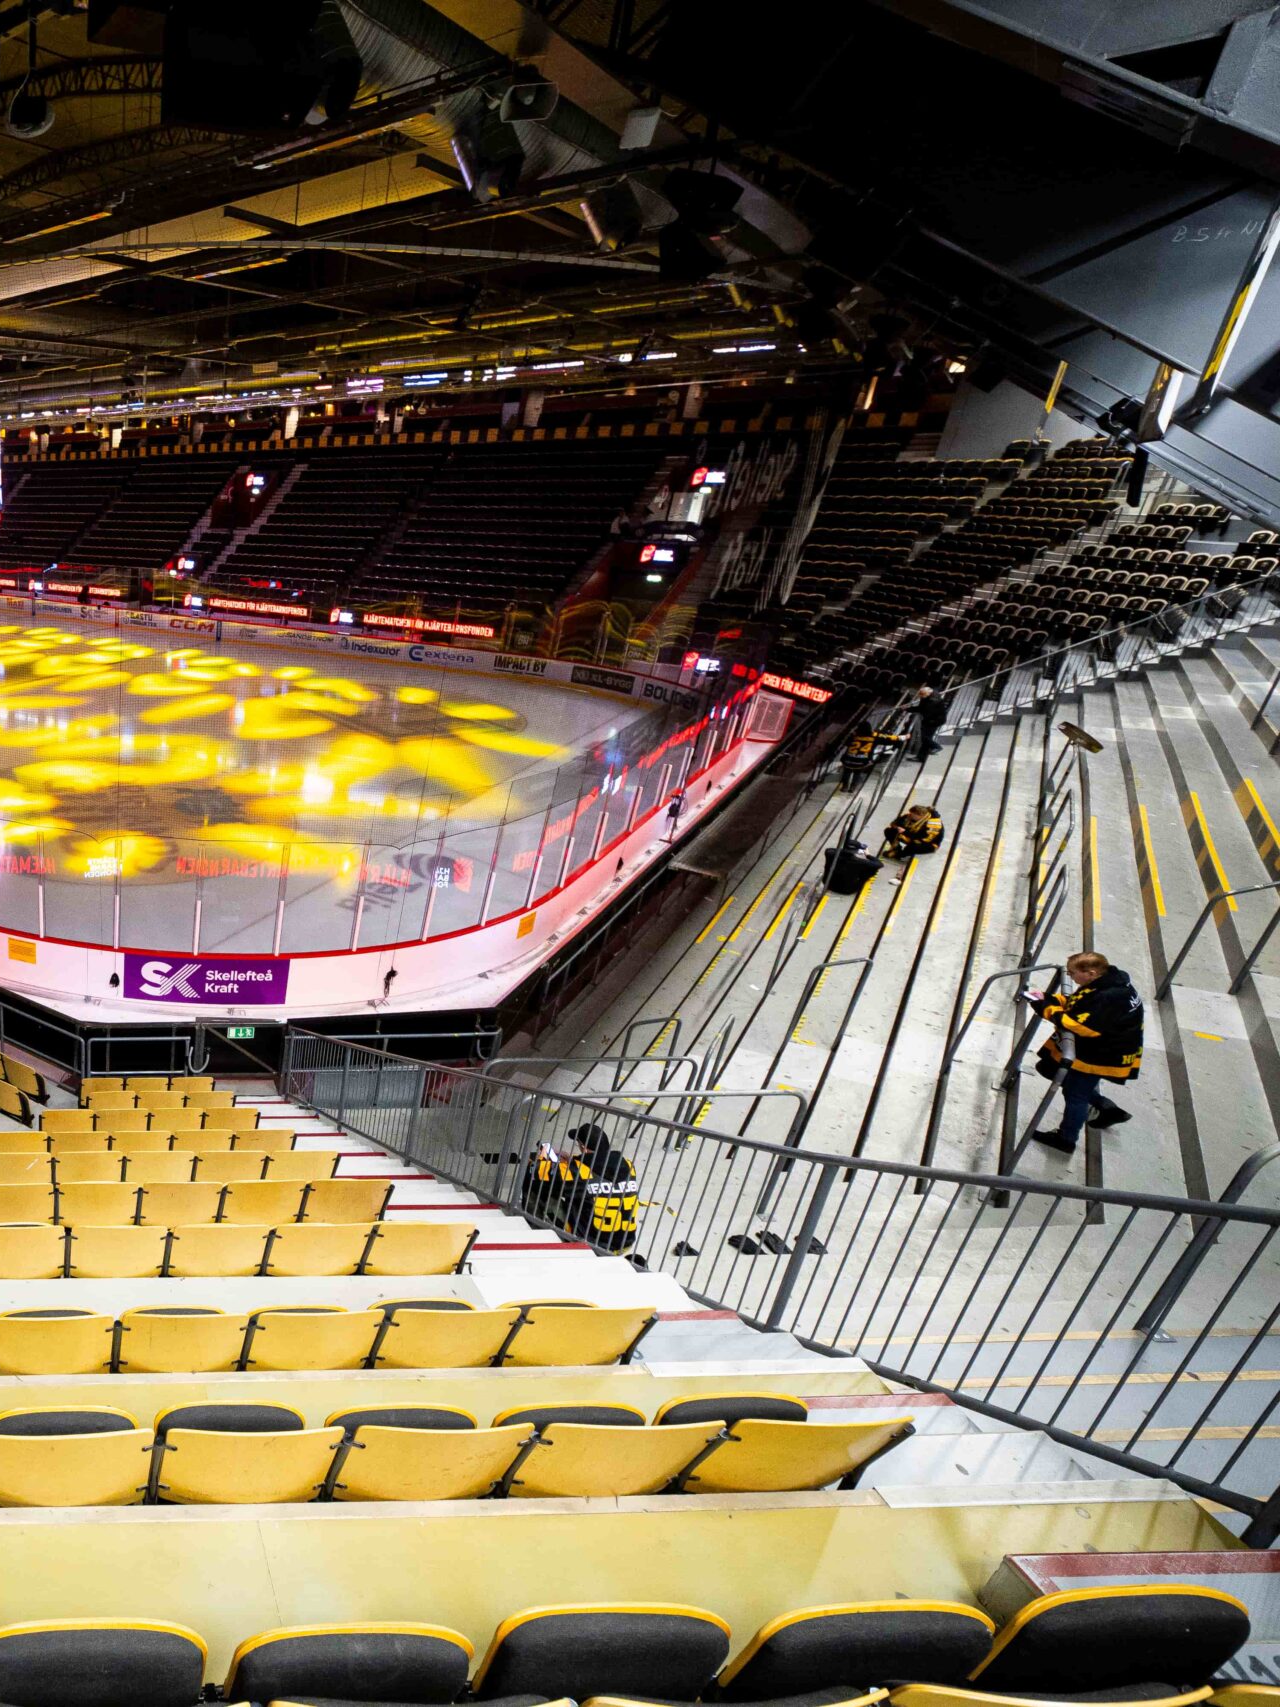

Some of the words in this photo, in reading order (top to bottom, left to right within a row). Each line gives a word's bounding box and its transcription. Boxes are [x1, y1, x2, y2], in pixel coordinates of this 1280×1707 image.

[209, 598, 246, 610] HJÄRTEMATCHEN
[246, 601, 256, 611] FÖR
[256, 602, 308, 617] HJÄRTEBARNSFONDEN
[169, 618, 215, 632] CCM
[363, 613, 411, 628] HJÄRTEMATCHEN
[351, 641, 401, 657] Indexator
[424, 650, 475, 663] extena
[493, 655, 531, 671] IMPACT
[532, 660, 548, 673] BY
[139, 960, 202, 999] SK
[205, 969, 273, 982] Skellefteå
[204, 982, 239, 994] Kraft
